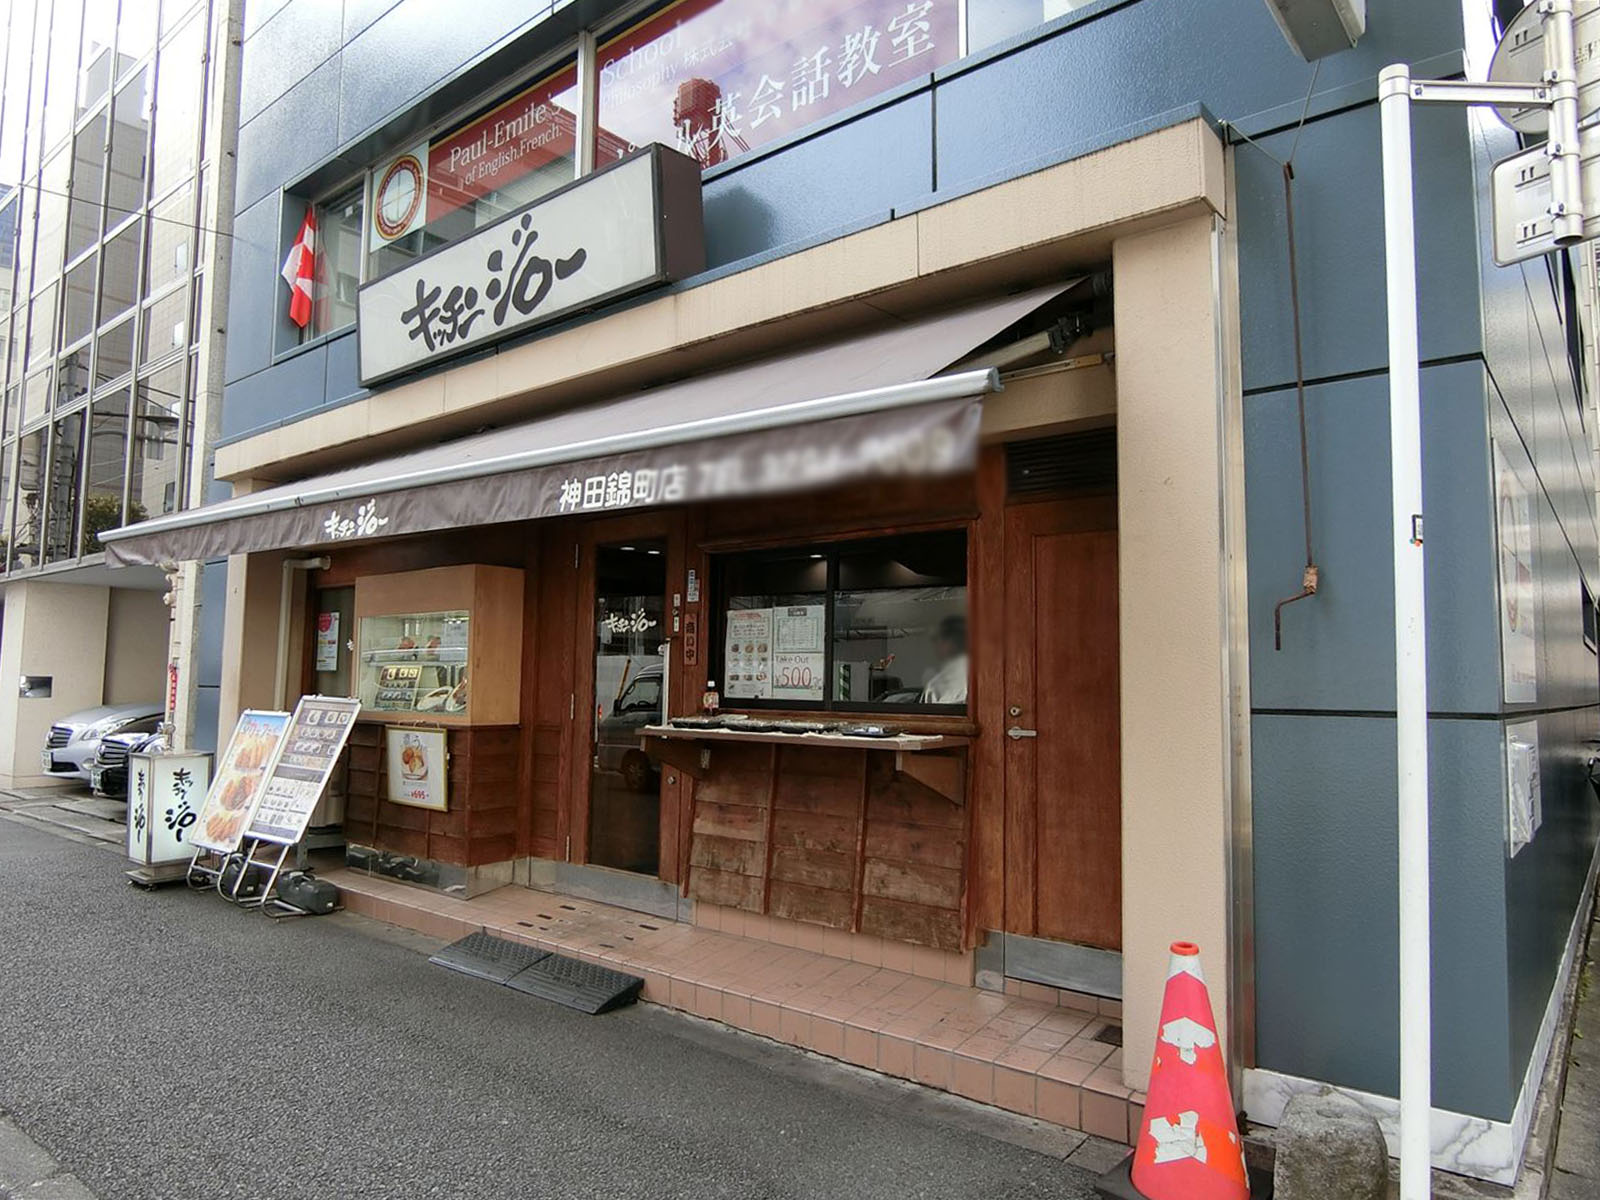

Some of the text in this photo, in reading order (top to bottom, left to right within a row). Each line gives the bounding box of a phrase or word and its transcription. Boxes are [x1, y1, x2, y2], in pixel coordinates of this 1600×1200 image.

[602, 20, 681, 88] School
[465, 165, 478, 185] of
[560, 466, 687, 512] 神田錦町店
[794, 655, 809, 664] Out
